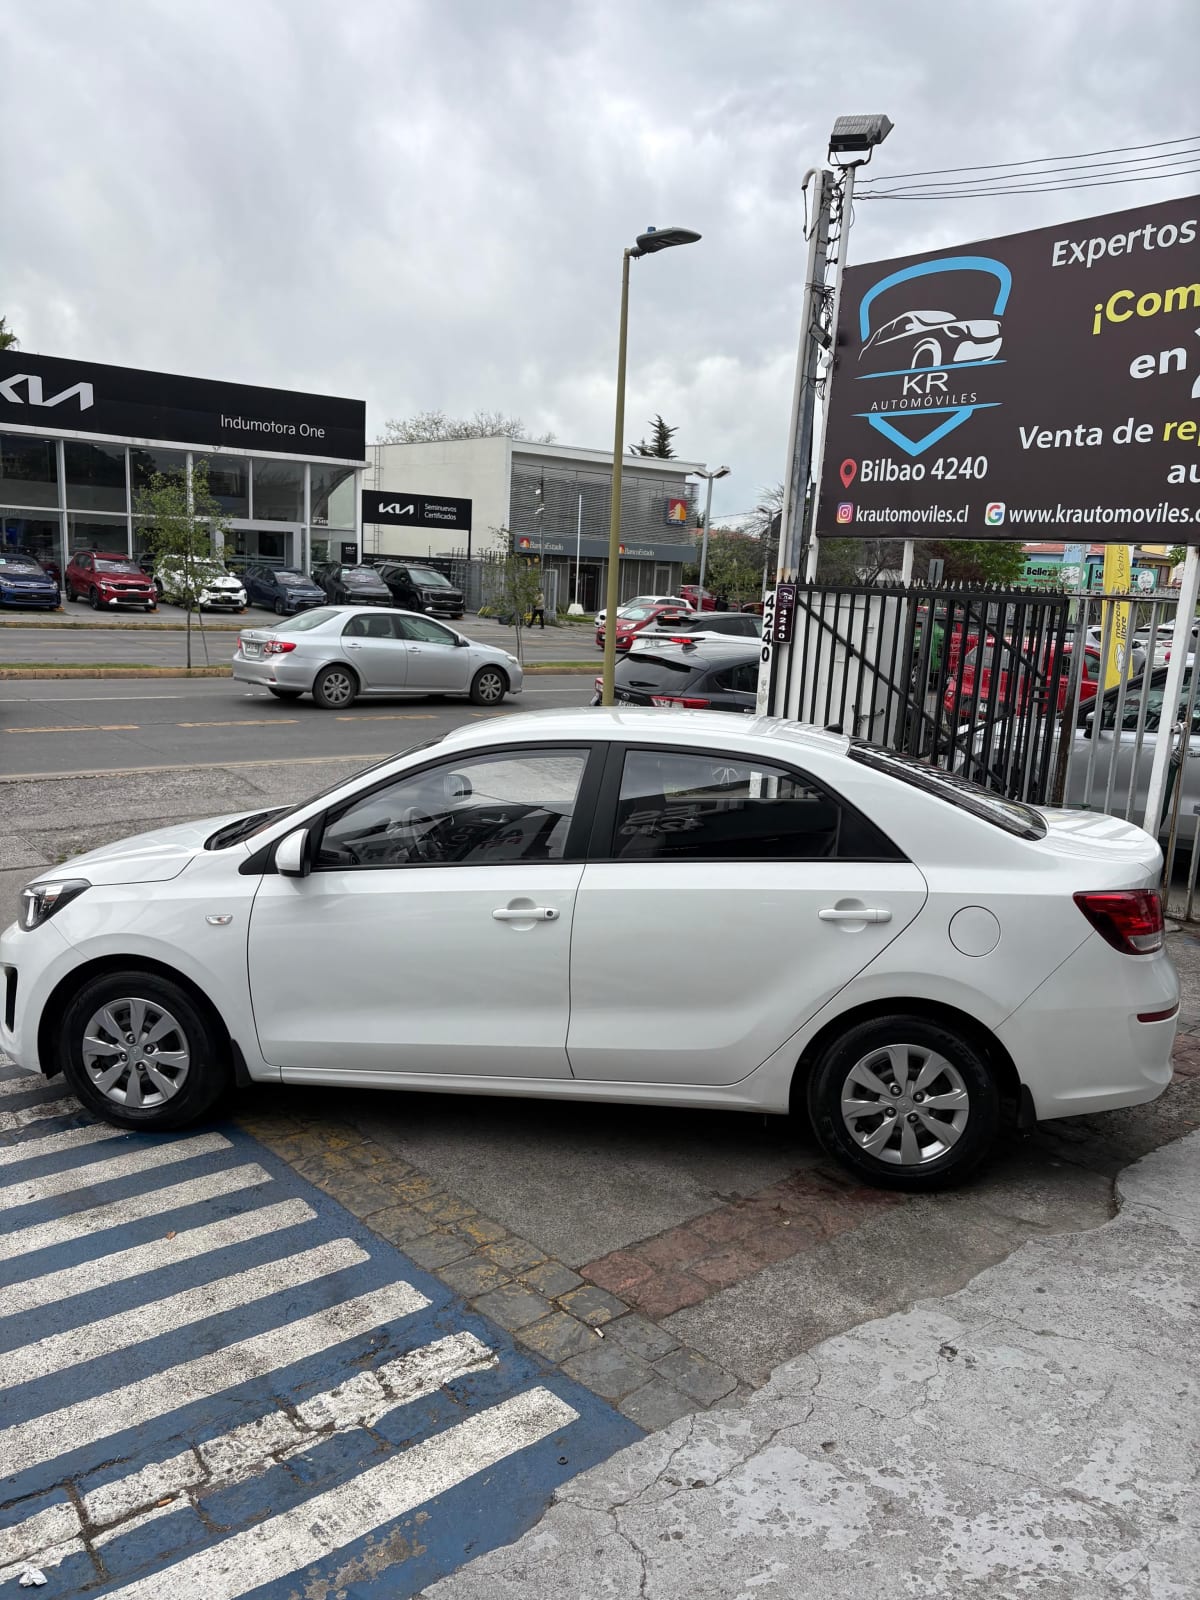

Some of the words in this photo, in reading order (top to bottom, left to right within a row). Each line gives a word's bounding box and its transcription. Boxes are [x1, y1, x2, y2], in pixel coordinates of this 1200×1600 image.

[1052, 220, 1198, 268] Expertos
[1129, 347, 1187, 379] en
[902, 372, 949, 395] KR
[870, 392, 977, 411] AUTOMÓVILES
[221, 414, 296, 435] Indumotora
[300, 423, 325, 439] One
[1019, 424, 1103, 450] Venta
[1112, 417, 1154, 444] de
[1163, 420, 1200, 447] re
[860, 458, 926, 482] Bilbao
[930, 455, 988, 481] 4240
[379, 502, 415, 515] KIA
[424, 503, 457, 513] Seminuevos
[424, 512, 457, 521] Certificados
[855, 505, 969, 523] krautomoviles.cl
[761, 594, 775, 662] 4240
[778, 609, 788, 639] 4240
